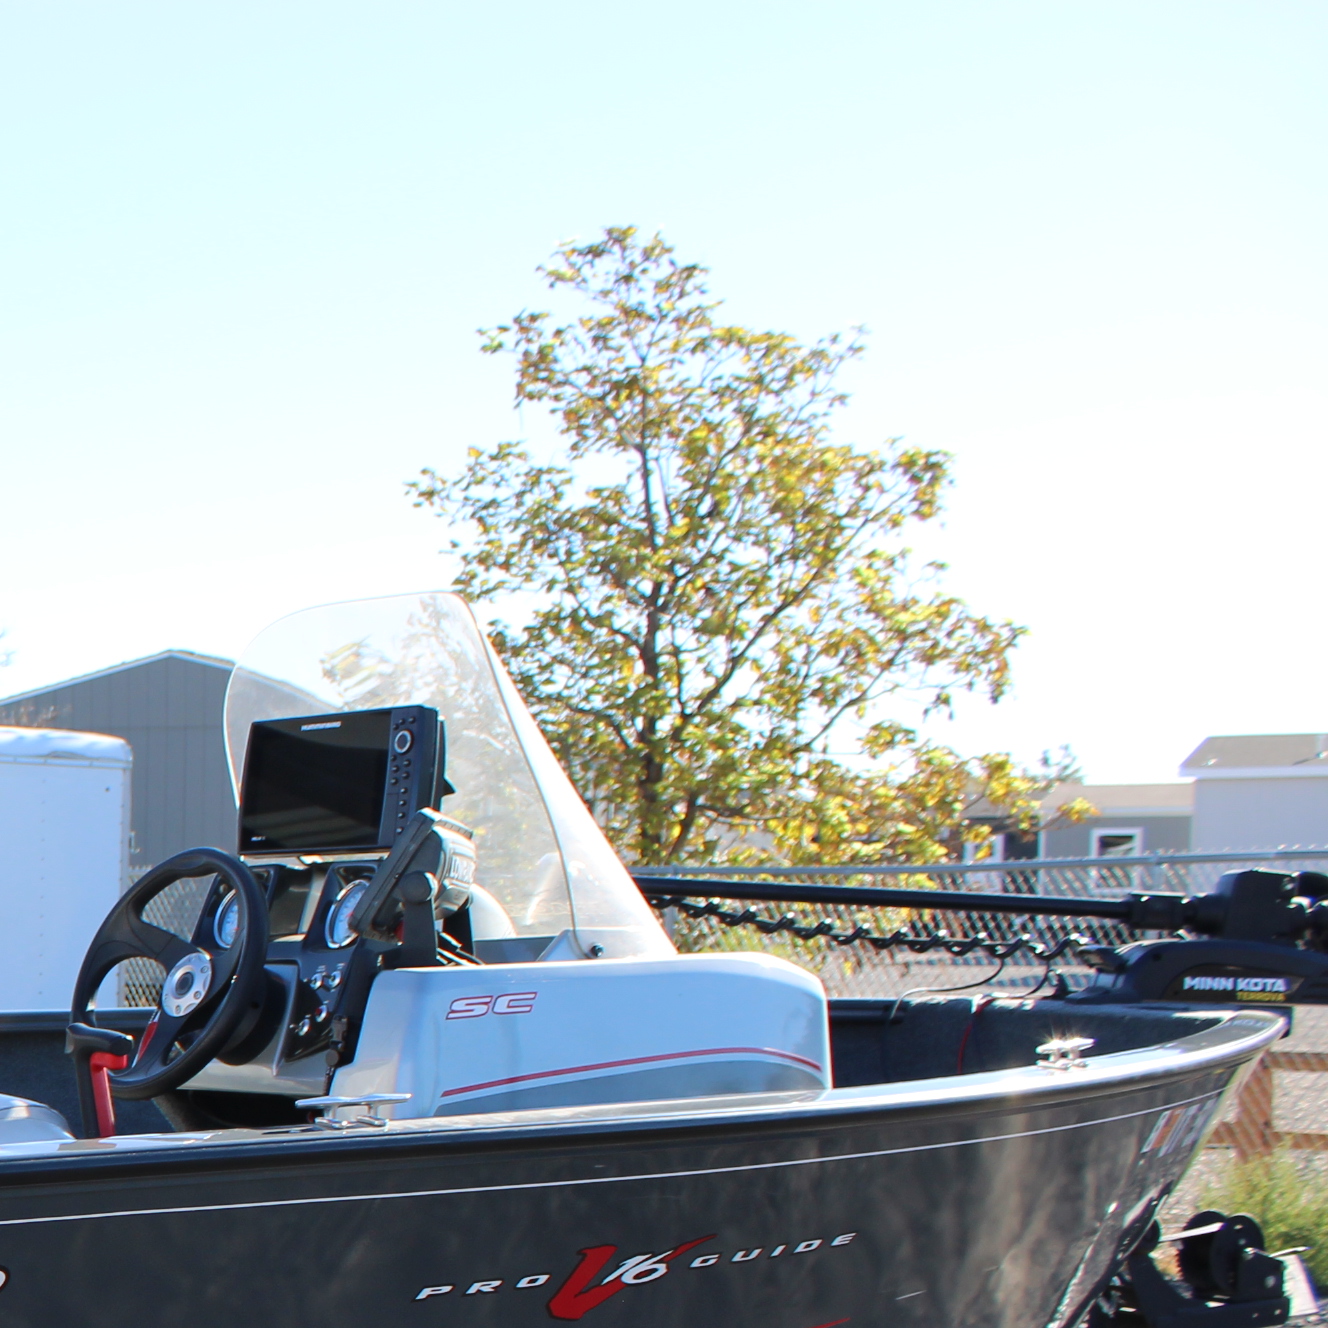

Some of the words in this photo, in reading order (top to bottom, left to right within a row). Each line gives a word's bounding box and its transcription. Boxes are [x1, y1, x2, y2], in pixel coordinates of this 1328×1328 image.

[1183, 976, 1234, 991] MINN
[1236, 977, 1287, 992] KOTA
[445, 991, 538, 1020] SC
[415, 1273, 551, 1301] PRO
[689, 1232, 858, 1268] GUIDE
